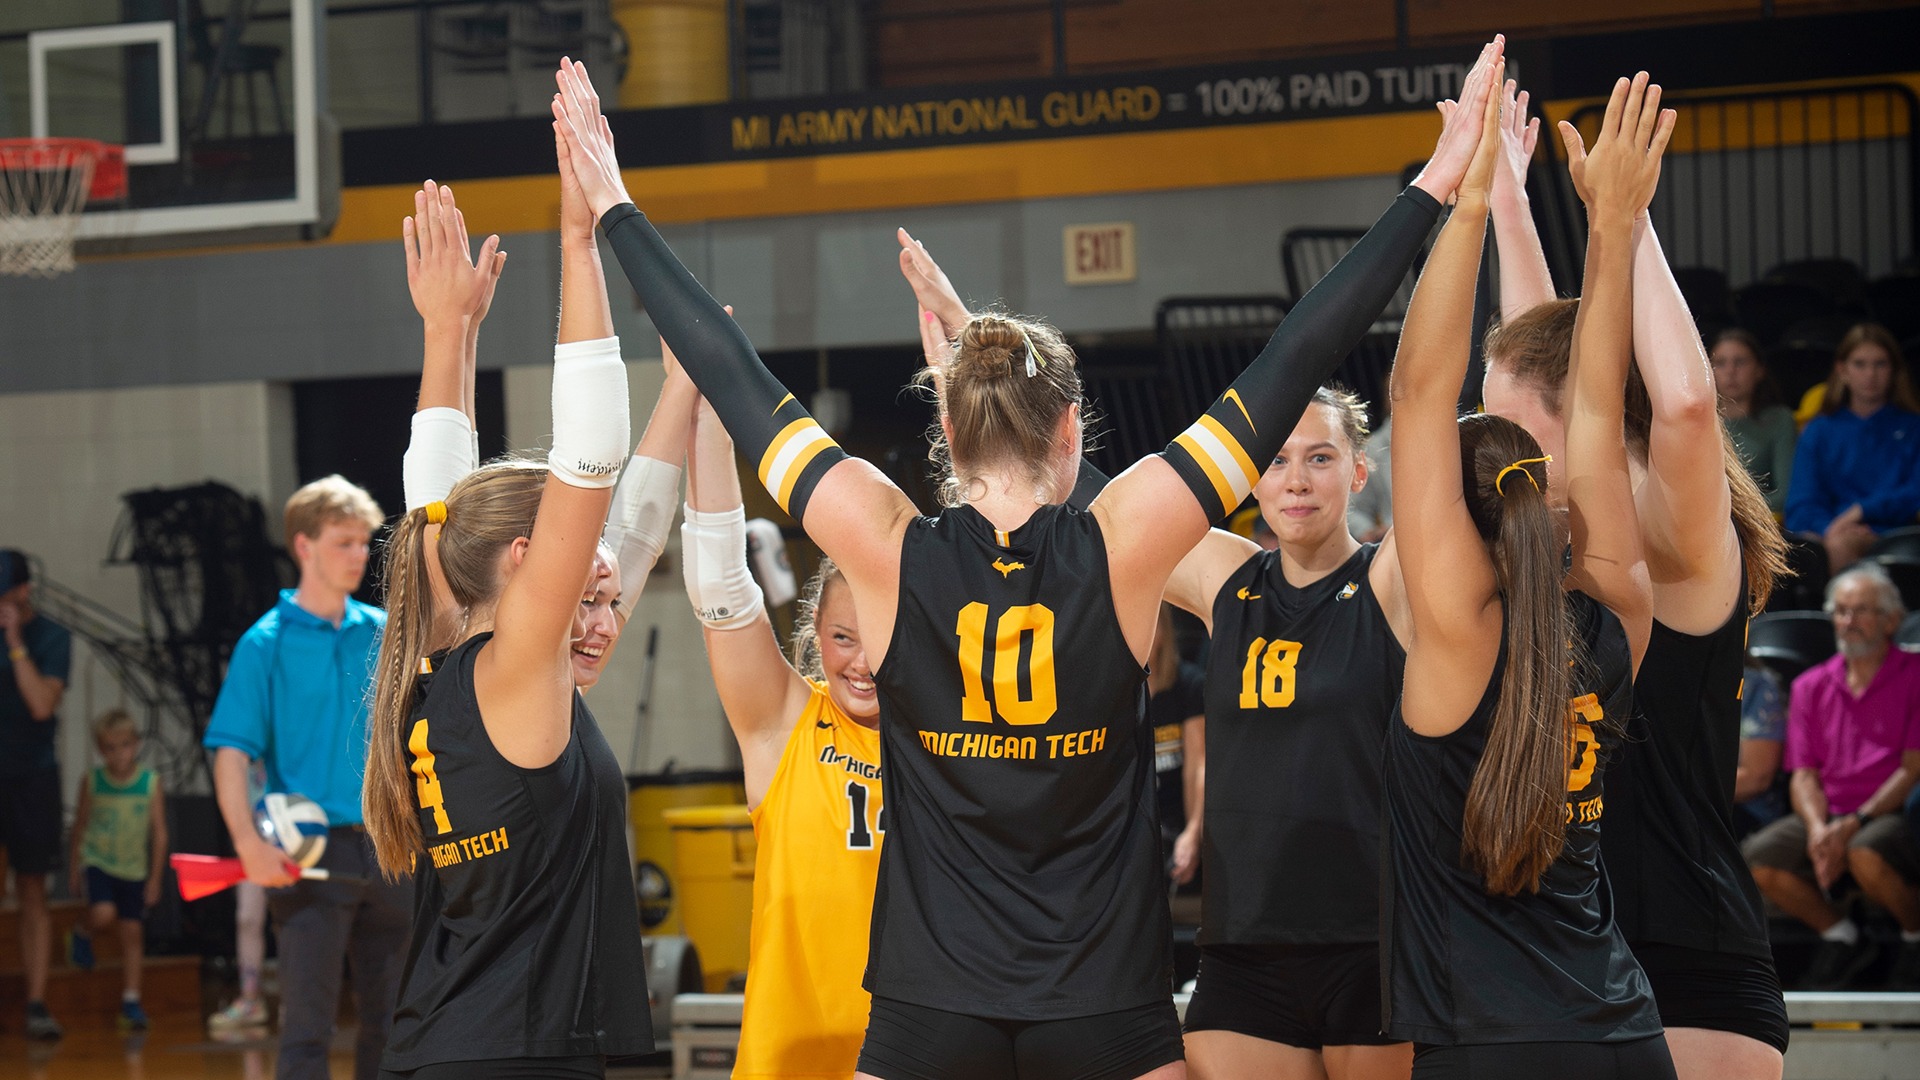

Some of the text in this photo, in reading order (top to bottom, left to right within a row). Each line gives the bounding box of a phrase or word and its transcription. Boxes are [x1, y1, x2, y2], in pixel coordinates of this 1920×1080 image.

[731, 114, 770, 151] MI
[776, 106, 868, 146] ARMY
[873, 94, 1038, 139] NATIONAL
[1042, 85, 1162, 128] GUARD
[1196, 76, 1284, 116] 100%
[1289, 70, 1371, 109] PAID
[1075, 228, 1123, 275] EXIT
[956, 601, 1058, 726] 10
[1239, 636, 1303, 709] 18
[408, 718, 453, 835] 4
[918, 726, 1107, 760] MICHIGAN TECH
[459, 826, 509, 861] TECH
